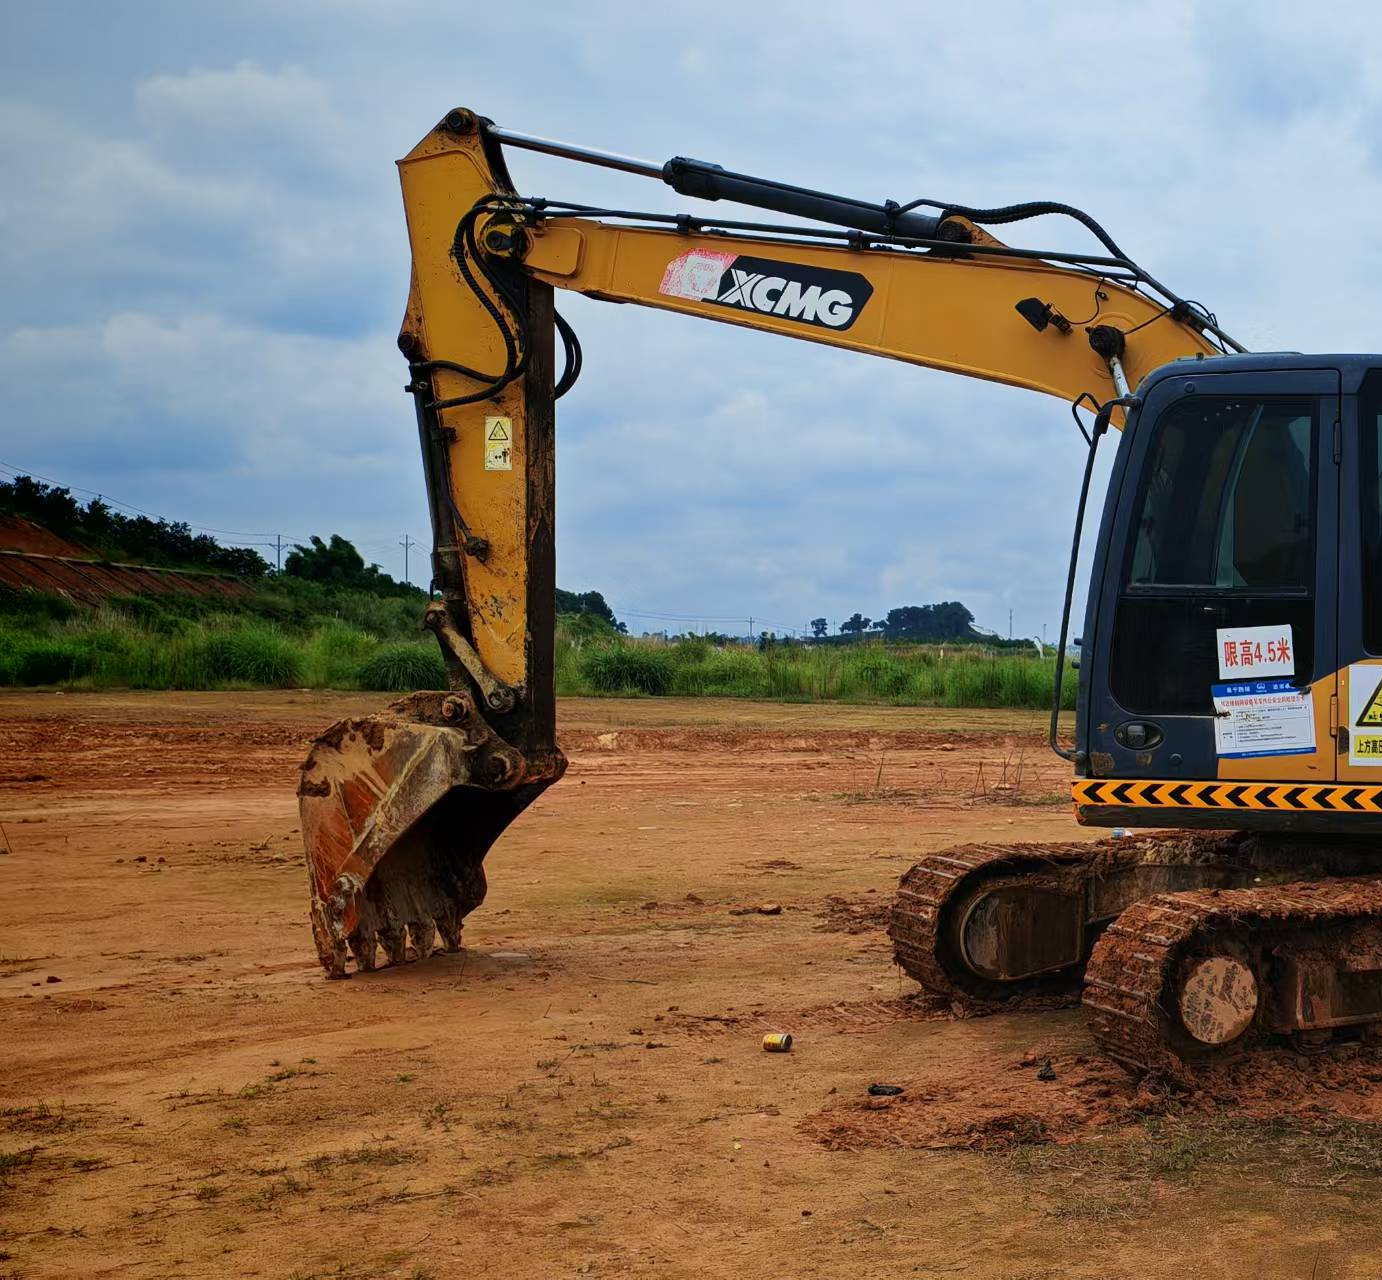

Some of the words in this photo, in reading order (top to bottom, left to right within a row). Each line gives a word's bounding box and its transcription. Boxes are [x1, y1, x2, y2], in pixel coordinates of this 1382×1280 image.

[718, 268, 853, 327] XCMG
[1223, 637, 1290, 668] 限高4.5米
